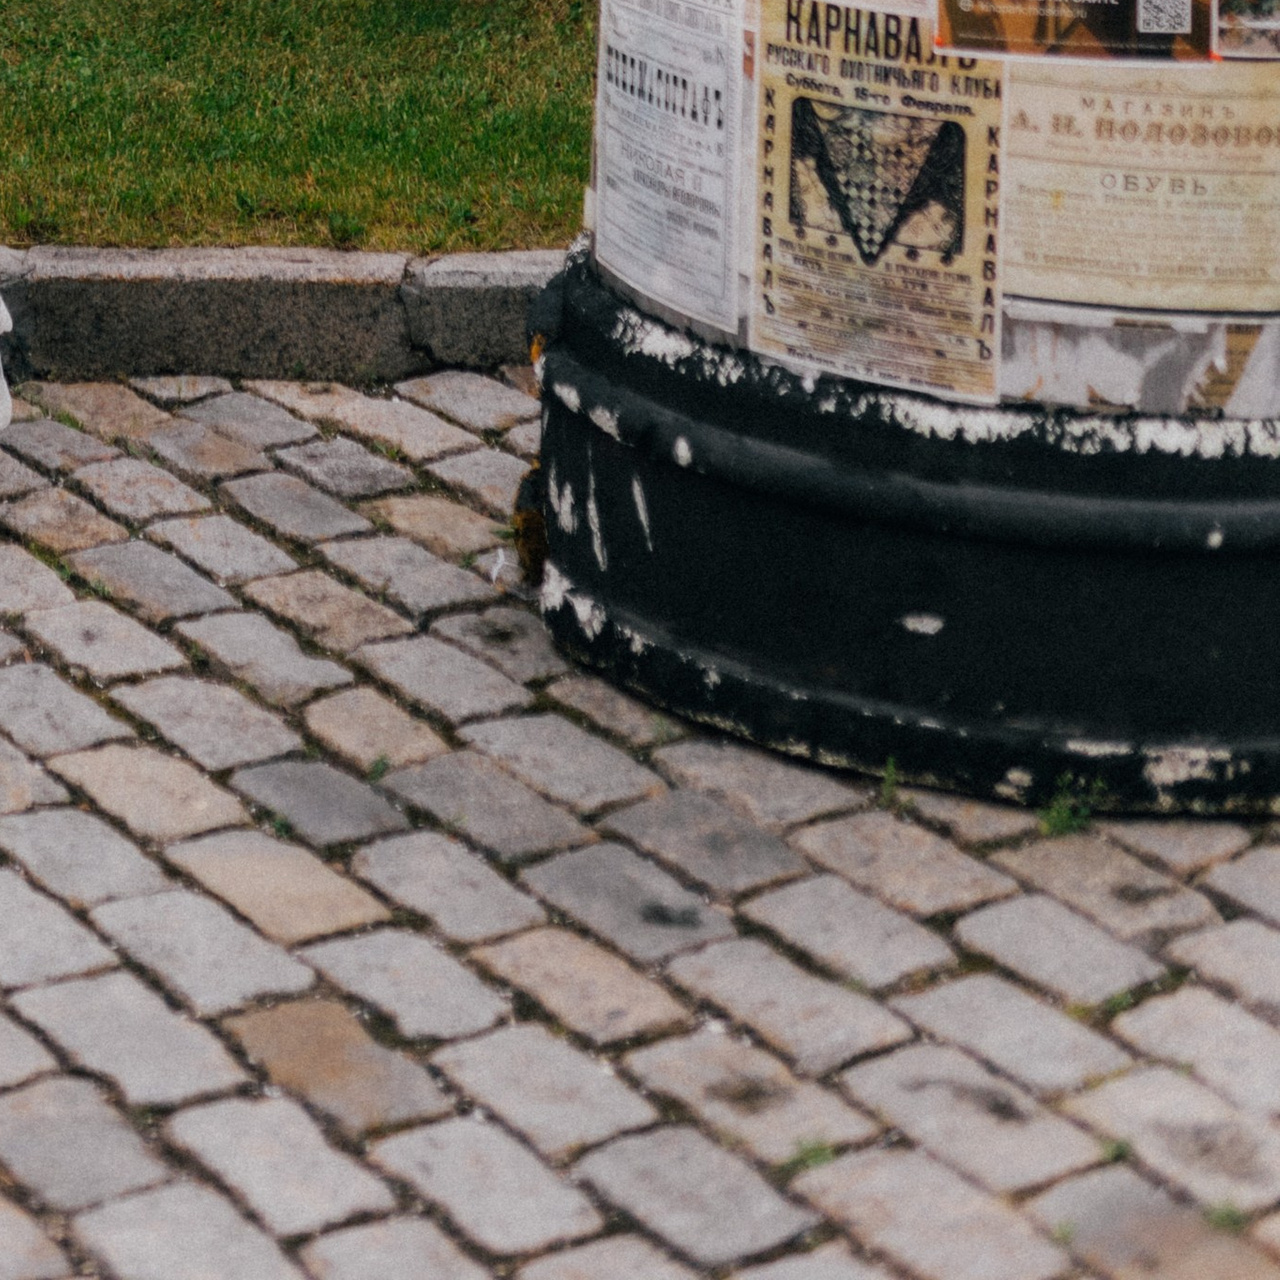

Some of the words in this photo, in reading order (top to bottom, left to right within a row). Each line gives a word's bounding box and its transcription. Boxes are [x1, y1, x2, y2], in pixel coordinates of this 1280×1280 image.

[767, 43, 831, 76] РУССКАГО
[840, 58, 940, 92] ОХОТНИЧЬЯГО
[951, 75, 1002, 99] КЛУБА
[854, 87, 890, 105] 15-го
[1082, 96, 1235, 119] МАГАЗИНЪ
[762, 86, 776, 316] КАРНАВАЛЪ
[1100, 174, 1207, 196] ОБУВЬ
[979, 126, 1000, 360] КАРНАВАЛЪ
